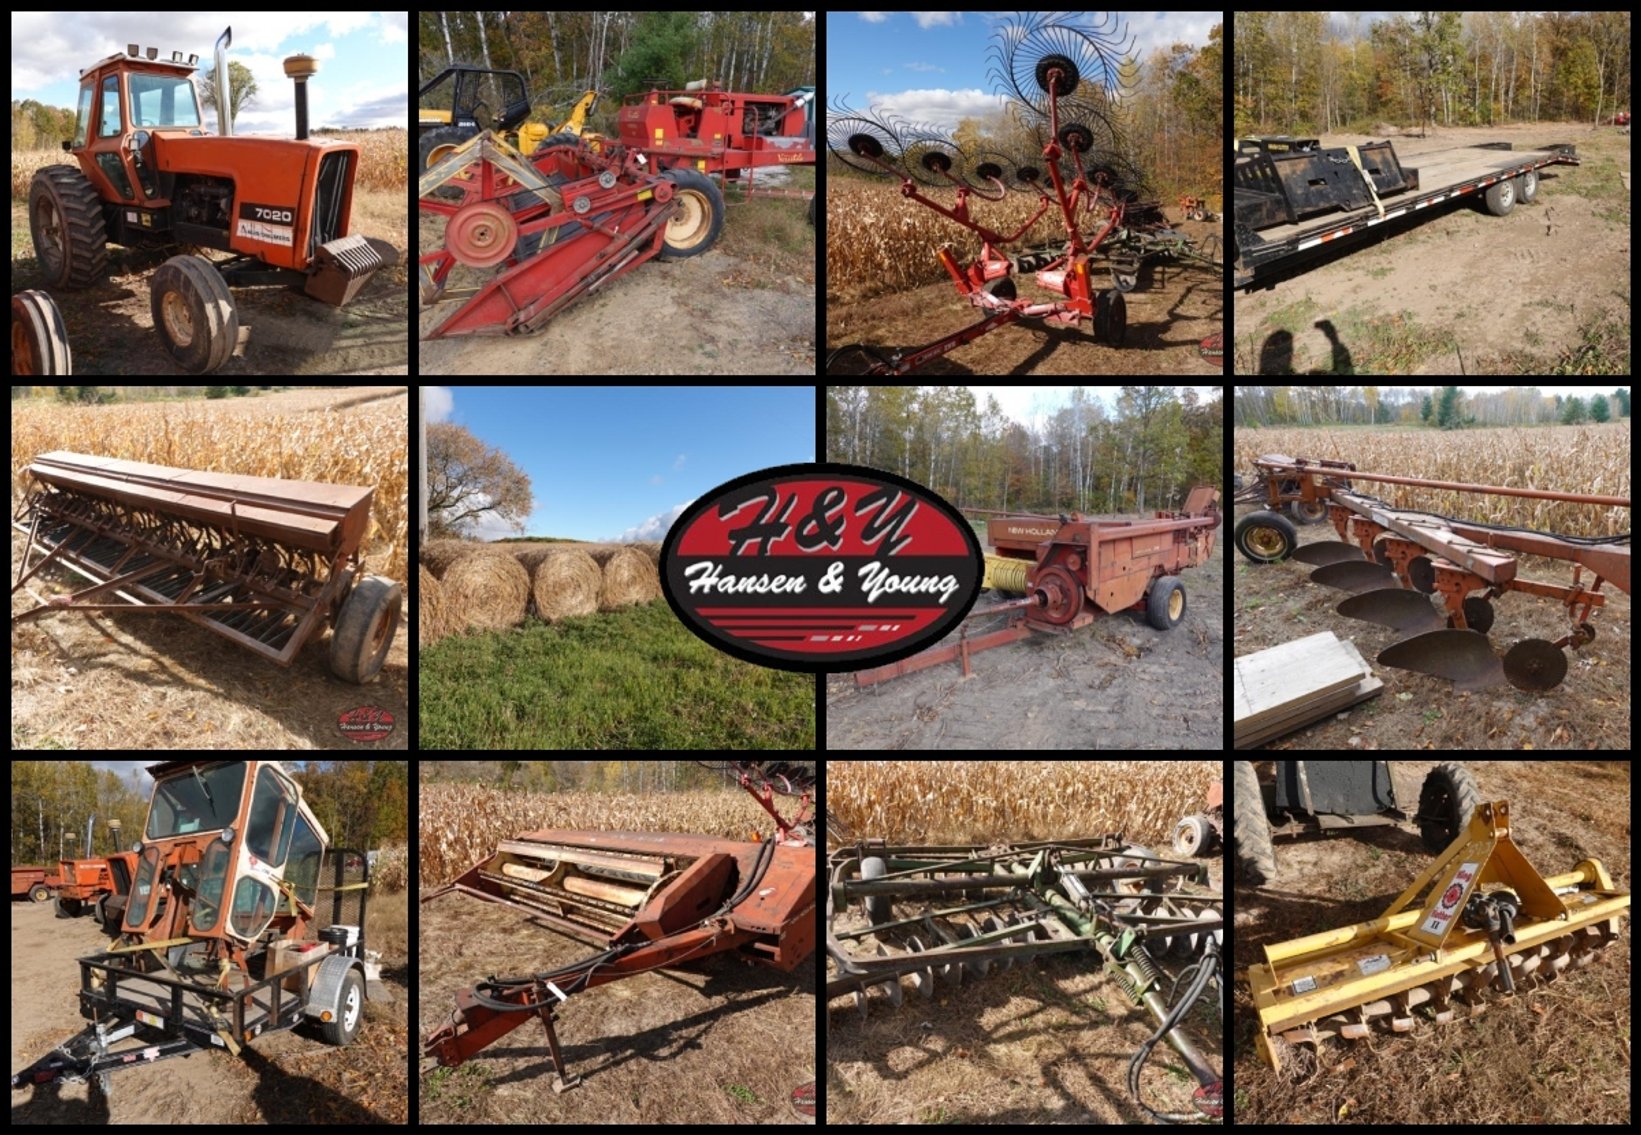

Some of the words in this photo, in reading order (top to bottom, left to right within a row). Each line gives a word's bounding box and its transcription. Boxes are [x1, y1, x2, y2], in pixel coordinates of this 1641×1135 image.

[255, 208, 292, 222] 7020
[1008, 527, 1024, 535] NEW
[1025, 528, 1058, 536] HOLLAN
